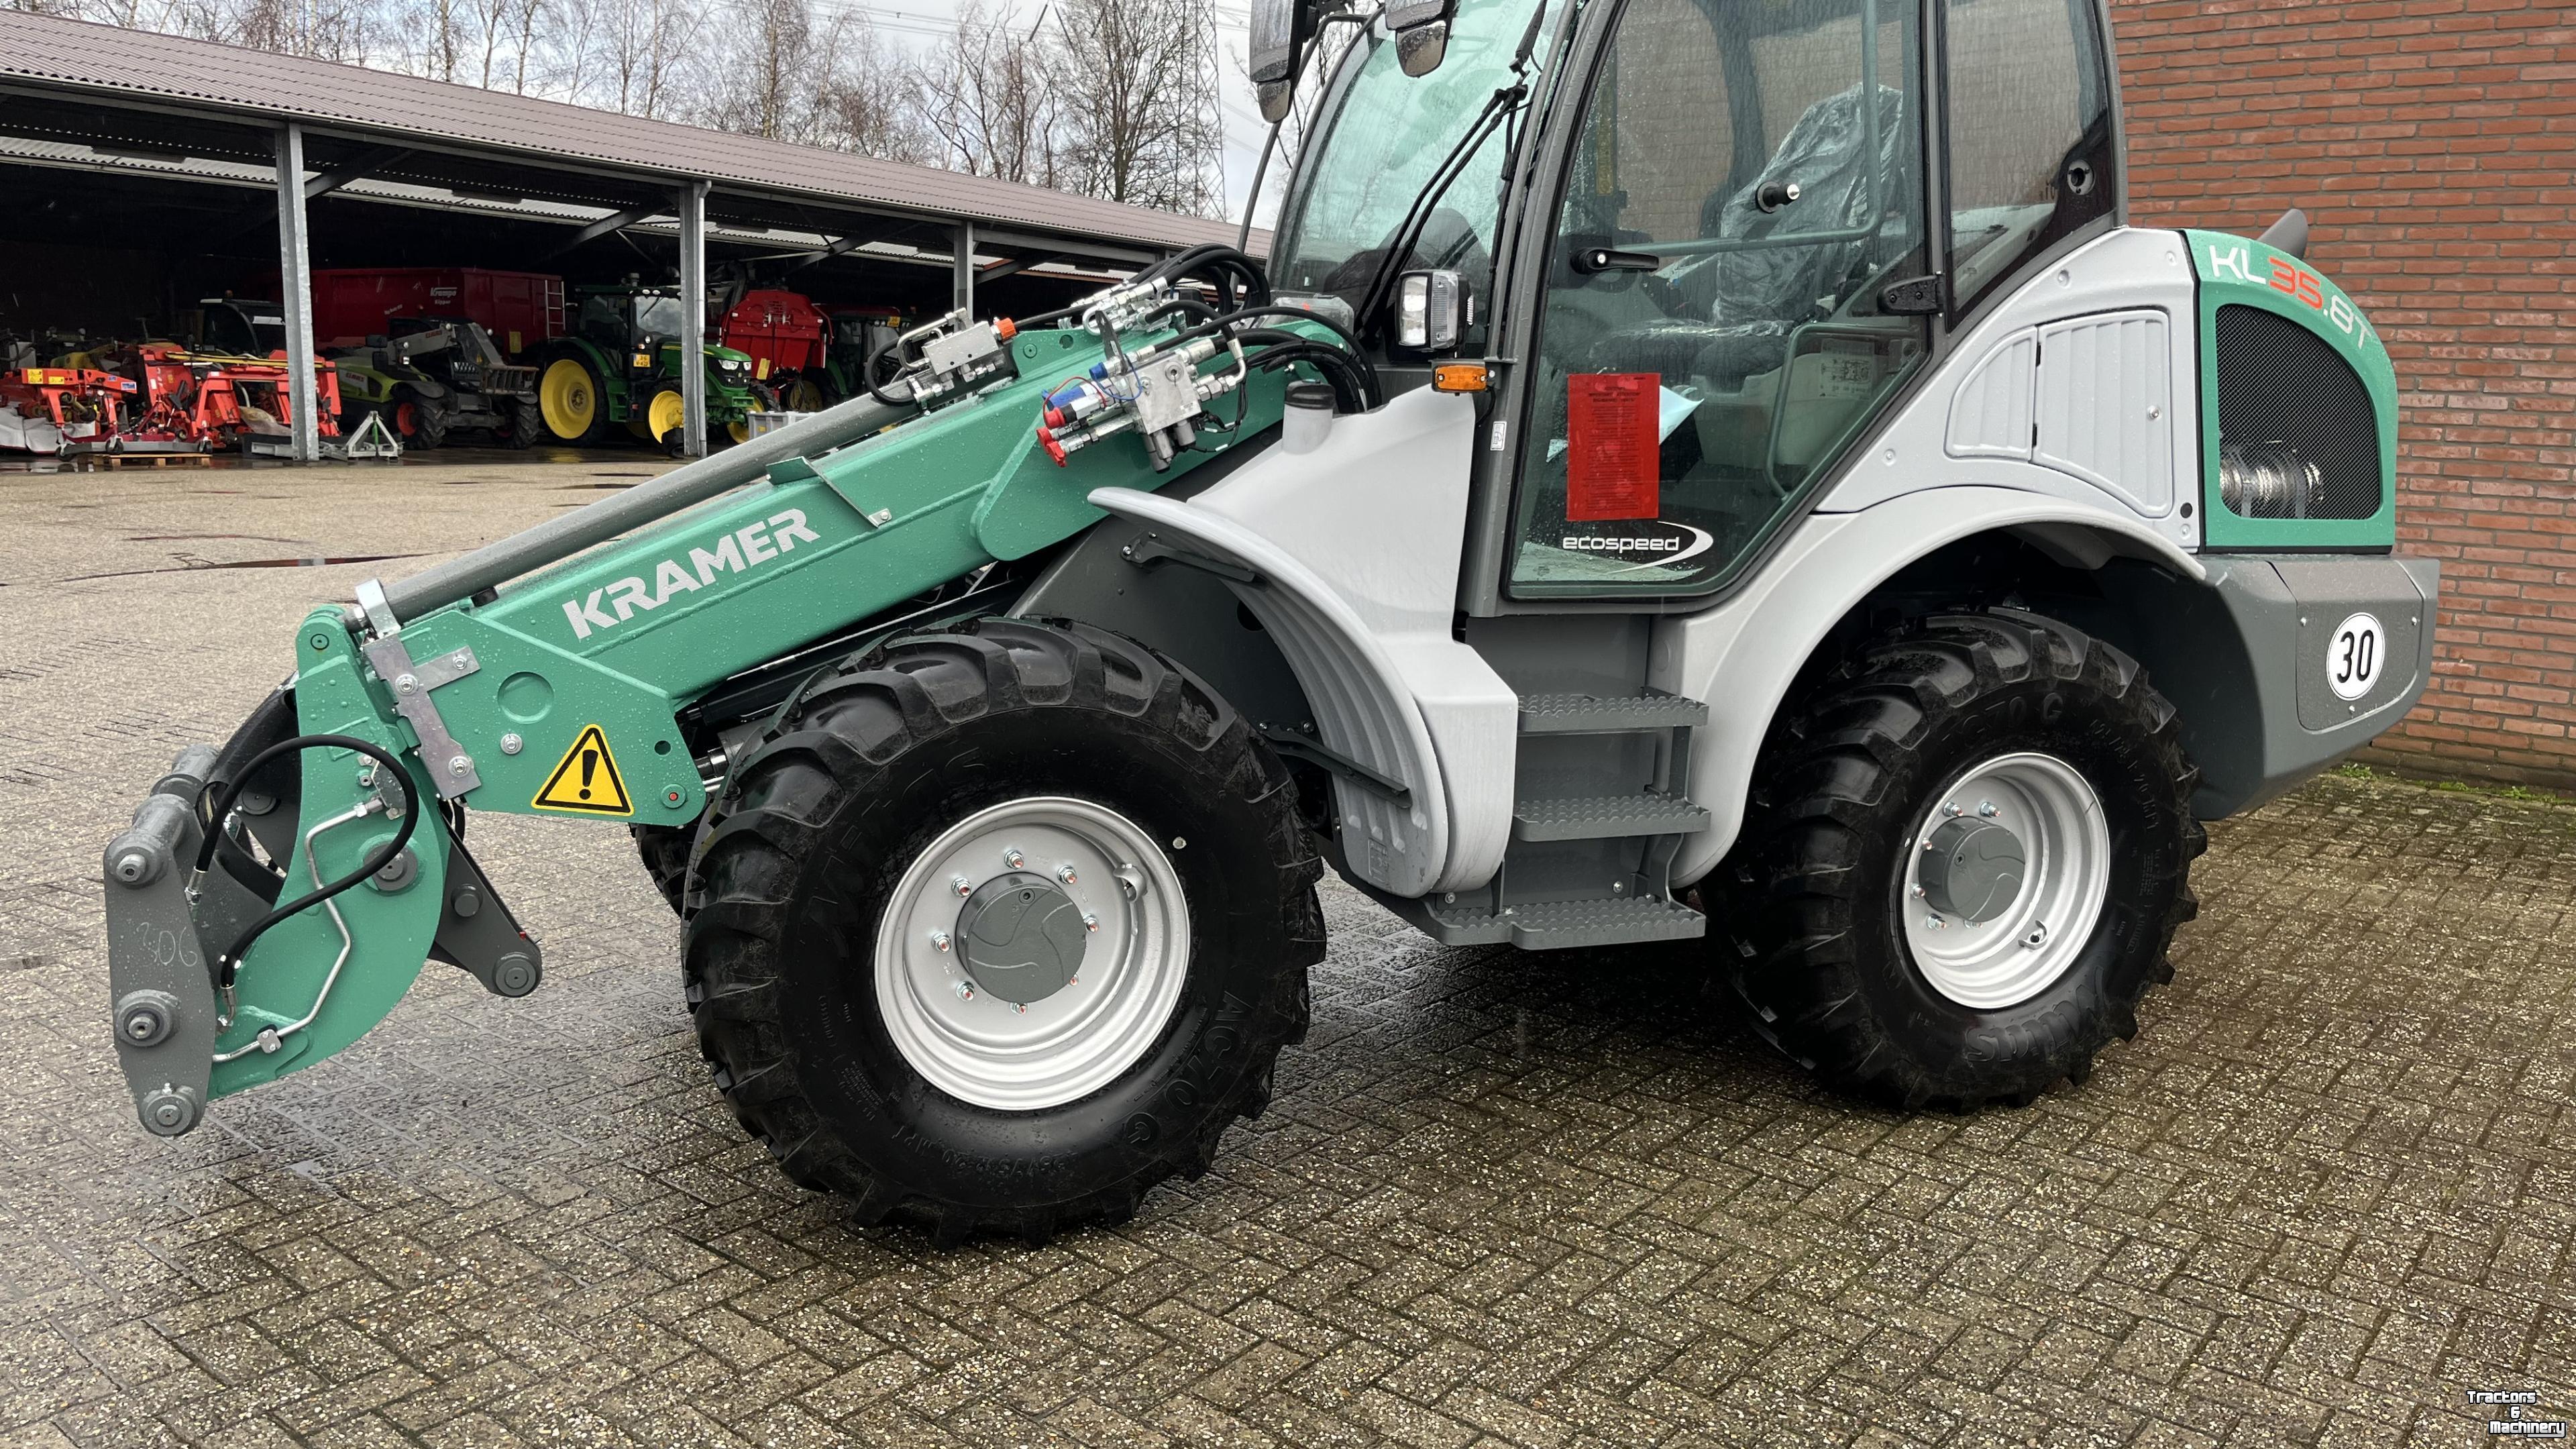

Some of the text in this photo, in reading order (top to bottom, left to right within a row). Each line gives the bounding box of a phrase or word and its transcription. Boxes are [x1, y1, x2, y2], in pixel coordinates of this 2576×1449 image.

[2209, 245, 2372, 349] KL35.8T
[1562, 536, 1680, 553] ecospeed
[561, 508, 821, 640] KRAMER
[2337, 629, 2374, 683] 30
[136, 922, 198, 967] 306
